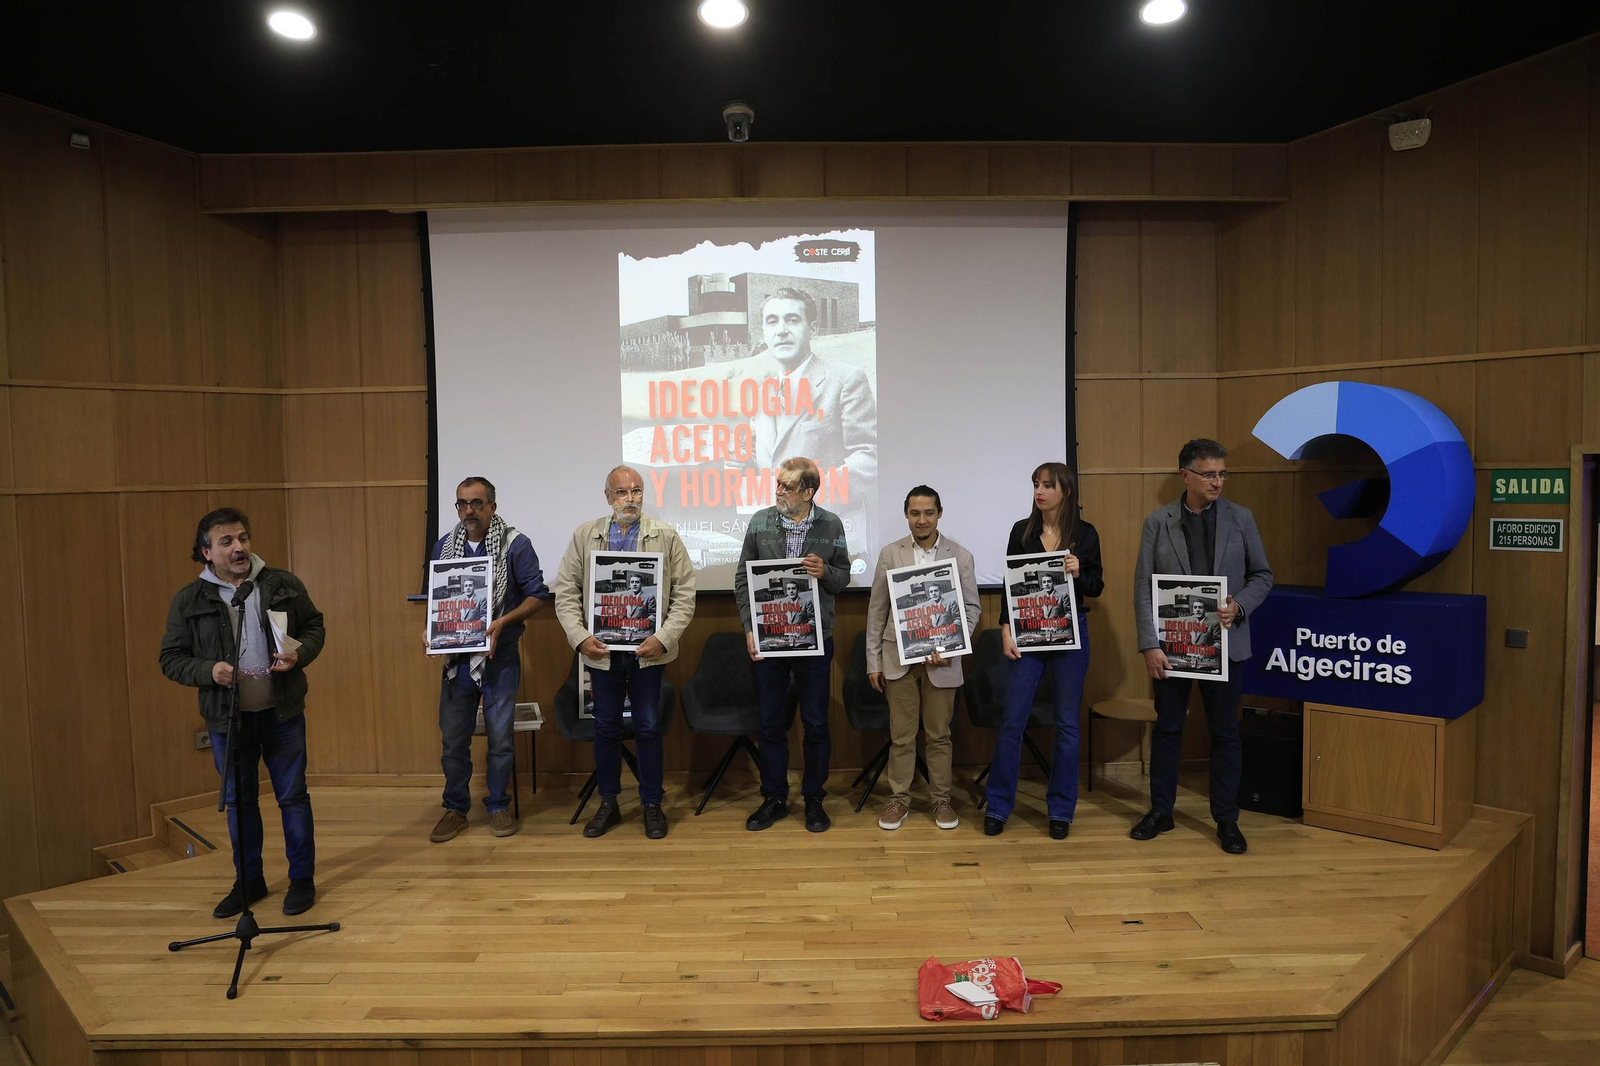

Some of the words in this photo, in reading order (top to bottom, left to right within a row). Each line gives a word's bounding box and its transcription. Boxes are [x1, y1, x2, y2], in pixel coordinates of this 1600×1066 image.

[803, 248, 828, 256] COSTE
[650, 423, 751, 463] ACERO
[650, 469, 668, 508] Y
[681, 459, 849, 508] HORMÓN
[1496, 478, 1565, 494] SALIDA
[1497, 524, 1523, 534] AFORO
[1524, 524, 1557, 534] EDIFICIO
[1499, 536, 1511, 545] 215
[1513, 536, 1554, 546] PERSONAS
[600, 618, 604, 626] Y
[1020, 620, 1024, 629] Y
[437, 623, 441, 632] Y
[763, 625, 767, 634] Y
[906, 631, 912, 640] Y
[1296, 627, 1371, 652] Puerto
[1376, 634, 1407, 655] de
[1165, 643, 1170, 652] Y
[1265, 648, 1412, 685] Algeciras
